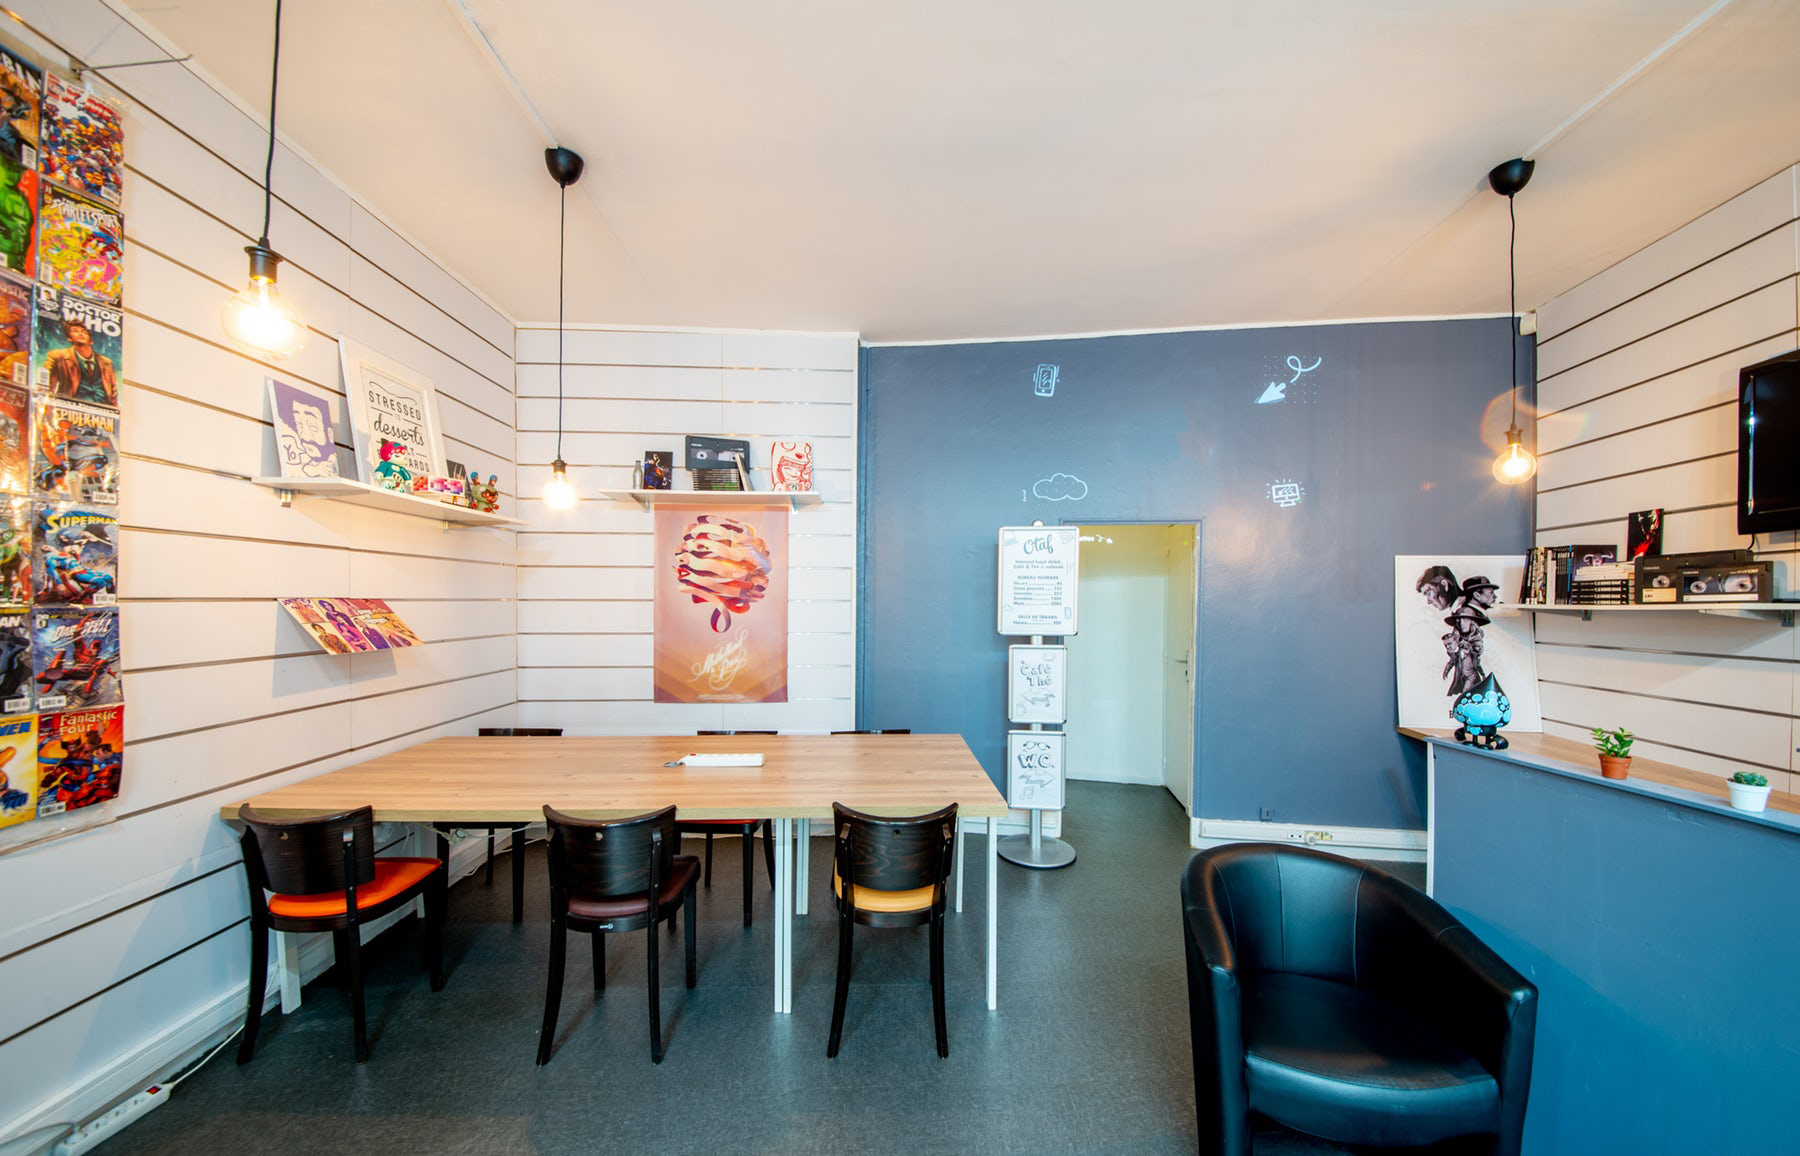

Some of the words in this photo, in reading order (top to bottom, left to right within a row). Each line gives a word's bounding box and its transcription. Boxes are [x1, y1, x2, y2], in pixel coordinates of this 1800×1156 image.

[63, 298, 120, 324] DOCTOR
[63, 307, 122, 337] WHO
[368, 390, 421, 421] STRESSED
[53, 407, 115, 433] SPIDER-MAN
[373, 414, 425, 447] desserts
[283, 443, 297, 462] Yo
[46, 515, 119, 534] SUPERMAN
[1020, 663, 1051, 676] Café
[1027, 675, 1052, 687] Thé
[59, 711, 118, 727] Fantastic
[59, 723, 94, 736] Four
[1017, 753, 1055, 769] W.C.
